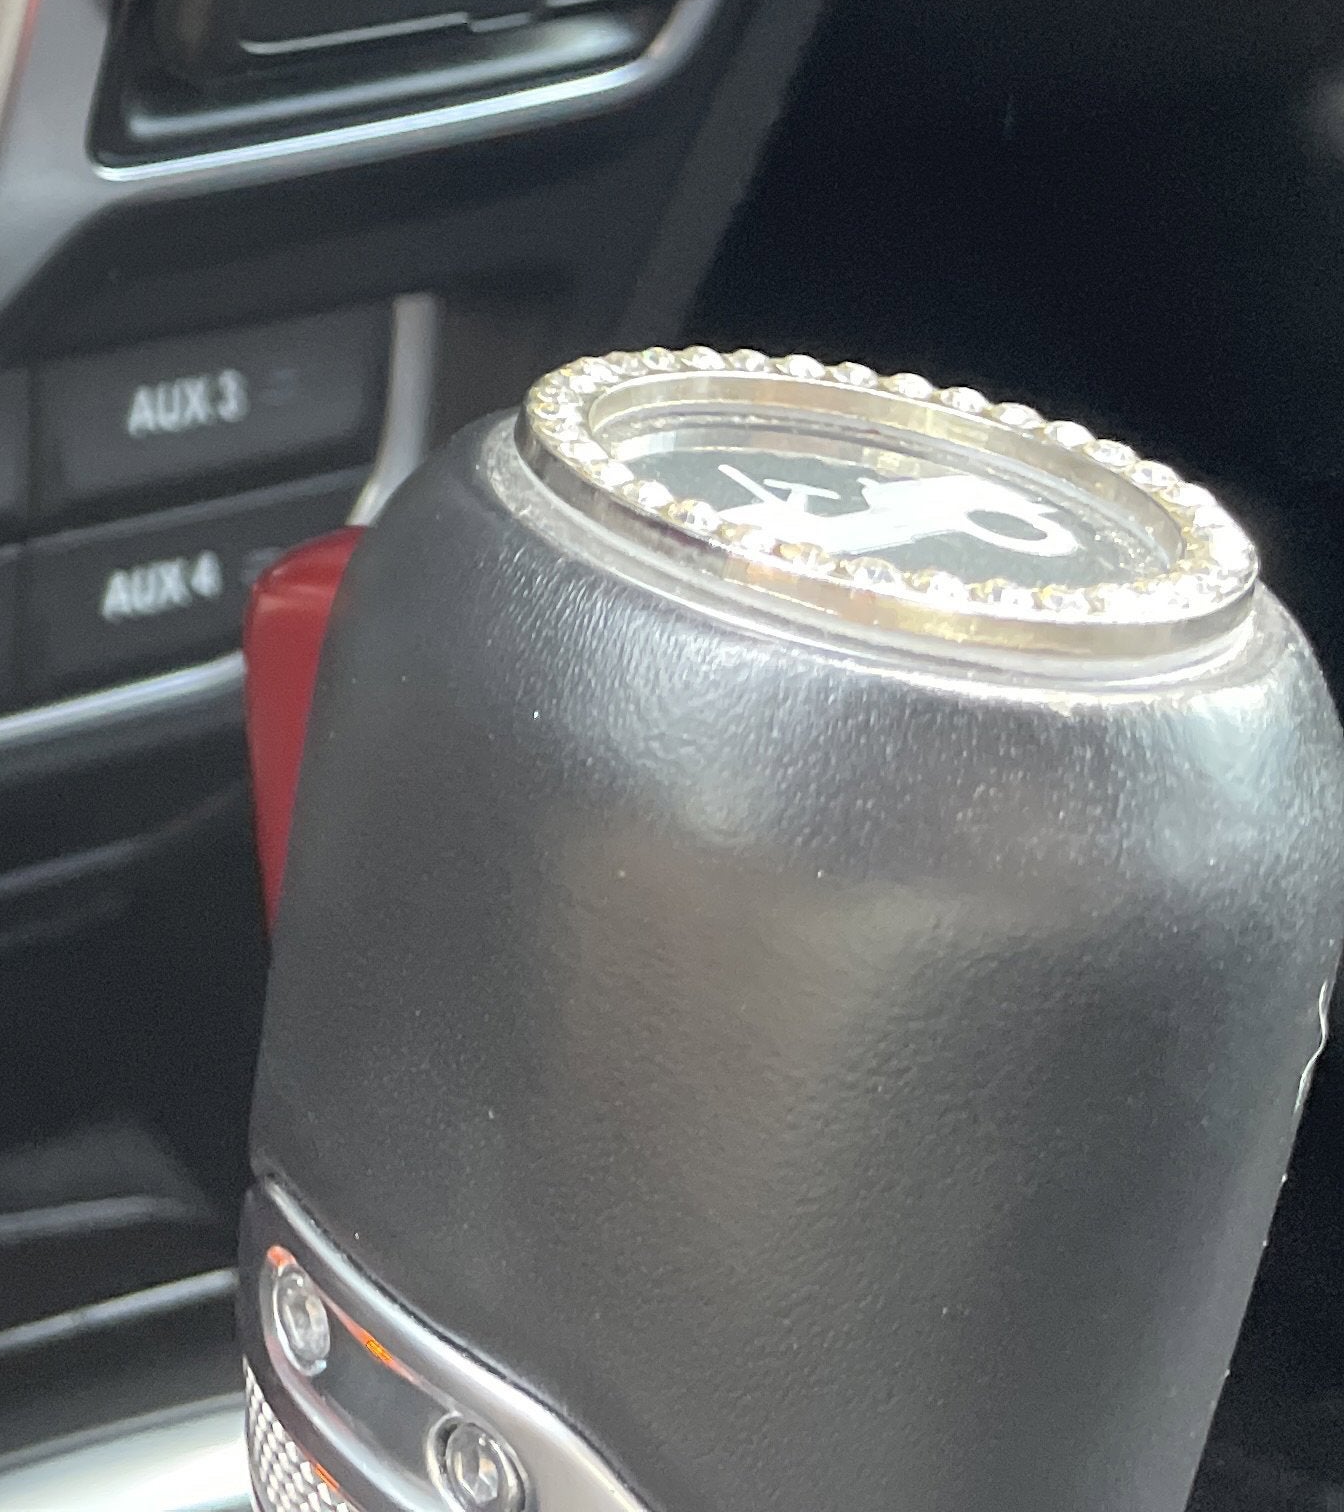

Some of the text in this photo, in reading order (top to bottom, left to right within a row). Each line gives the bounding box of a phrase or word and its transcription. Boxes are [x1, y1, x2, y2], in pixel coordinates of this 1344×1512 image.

[127, 368, 247, 435] AUX 3
[102, 550, 222, 620] AUX 4
